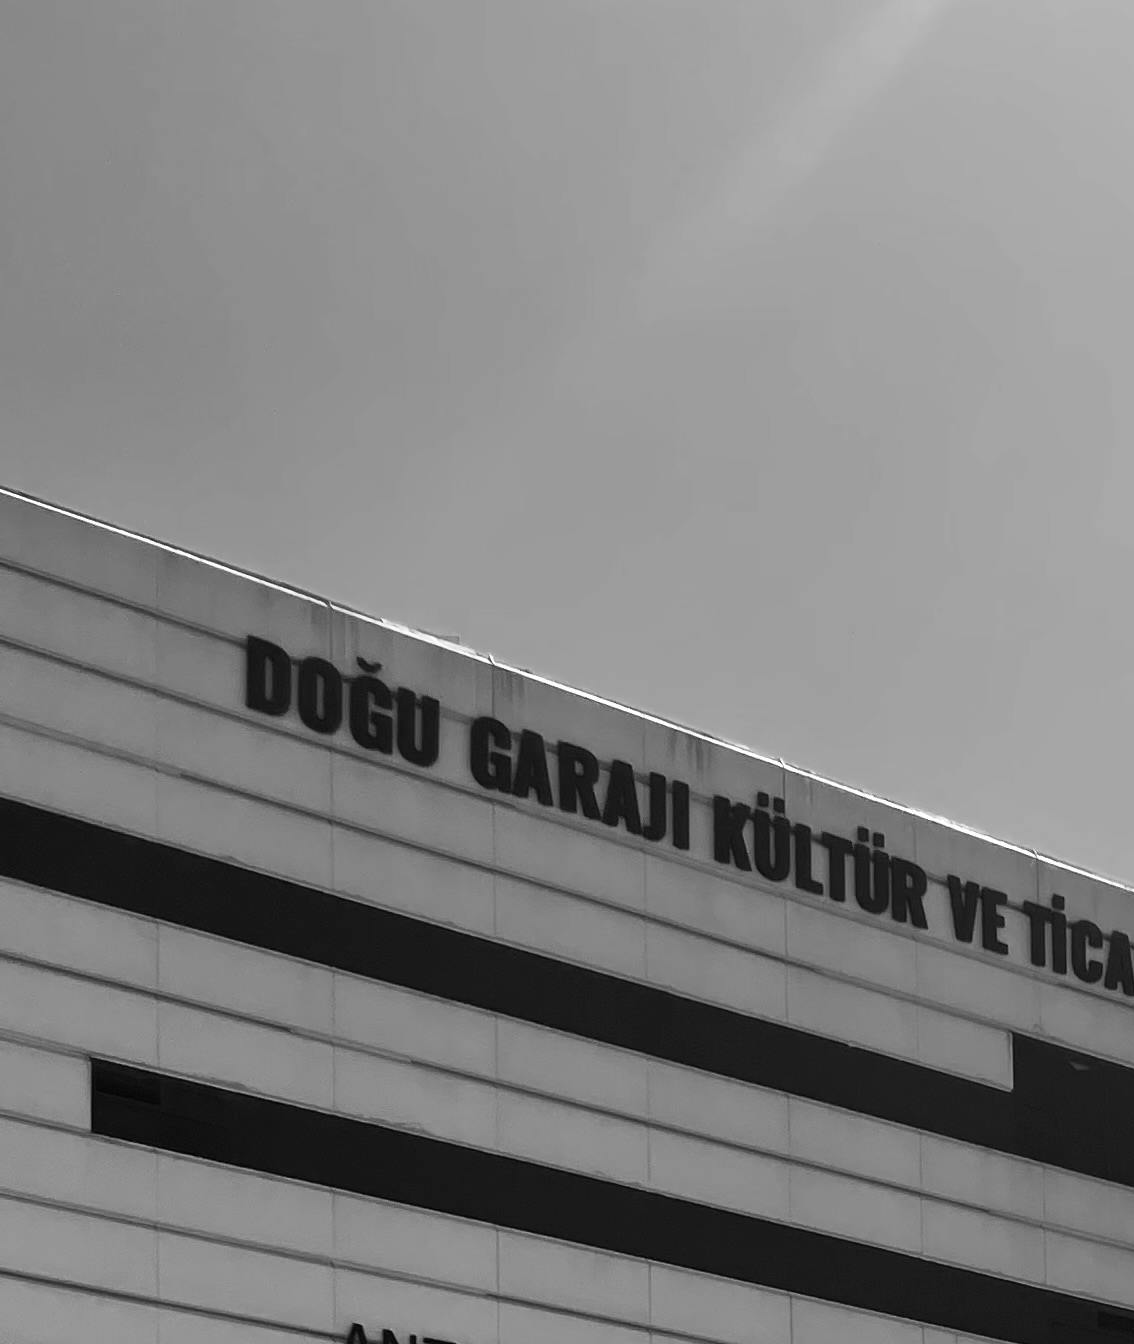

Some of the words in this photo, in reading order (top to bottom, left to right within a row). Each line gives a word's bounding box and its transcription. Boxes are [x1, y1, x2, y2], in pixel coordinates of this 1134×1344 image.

[244, 635, 441, 768] DOĞU
[469, 714, 691, 851] GARAJI
[711, 790, 929, 930] KÜLTÜR
[947, 874, 1009, 957] VE
